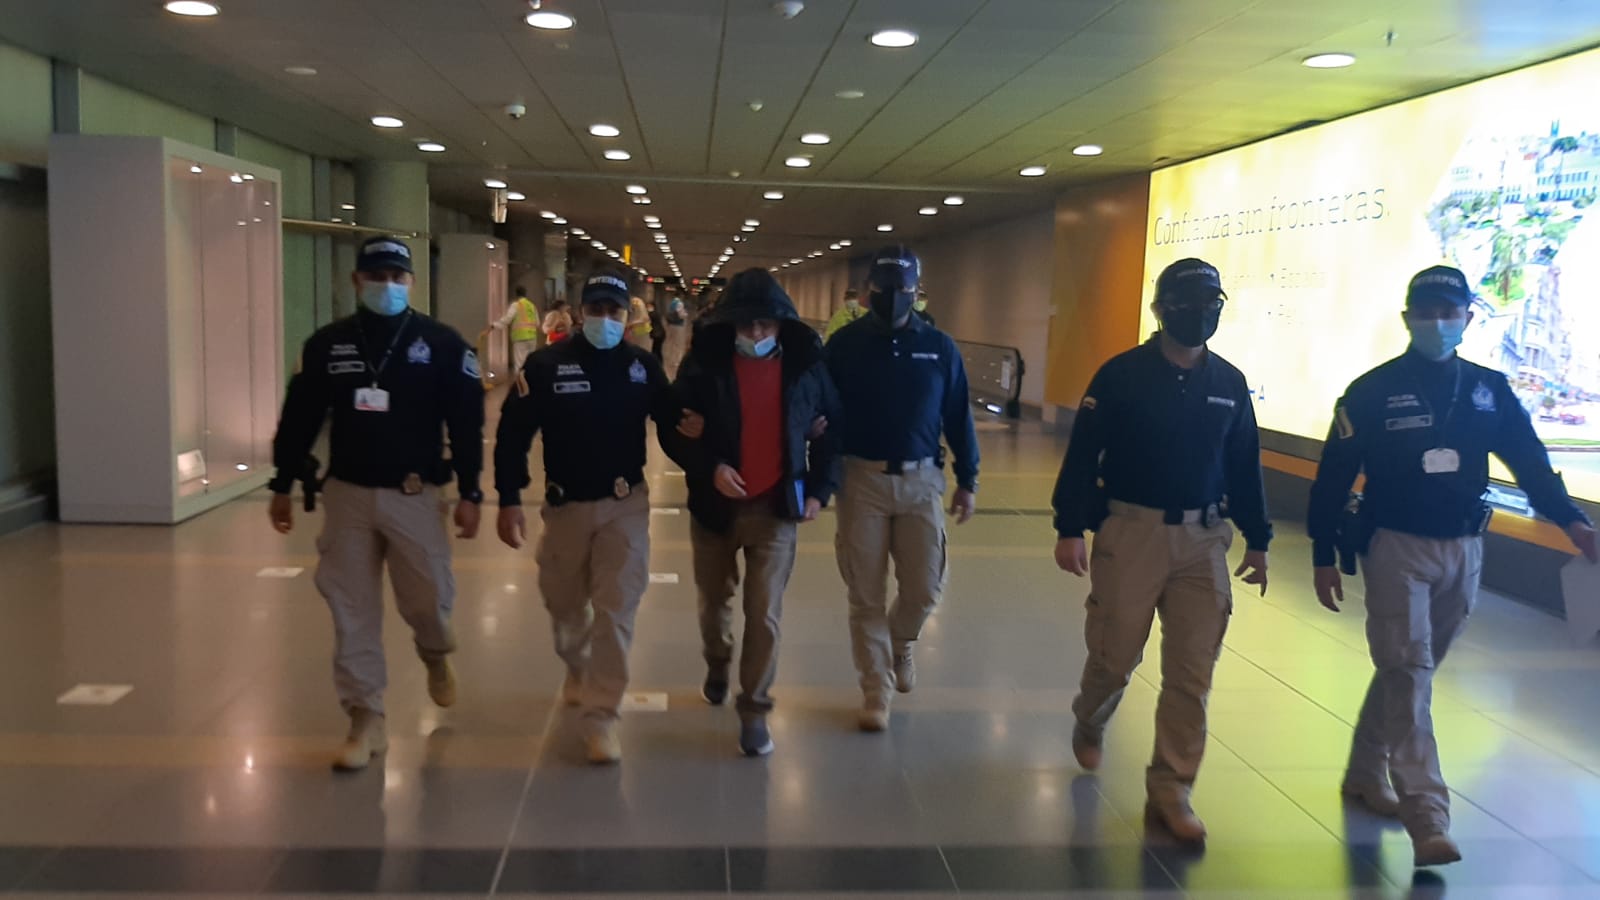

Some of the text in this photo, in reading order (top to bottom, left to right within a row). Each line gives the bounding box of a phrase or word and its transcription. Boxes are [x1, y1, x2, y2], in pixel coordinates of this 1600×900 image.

[1154, 211, 1230, 246] Confianza
[1235, 203, 1264, 236] sin
[588, 275, 628, 291] INTERPOL
